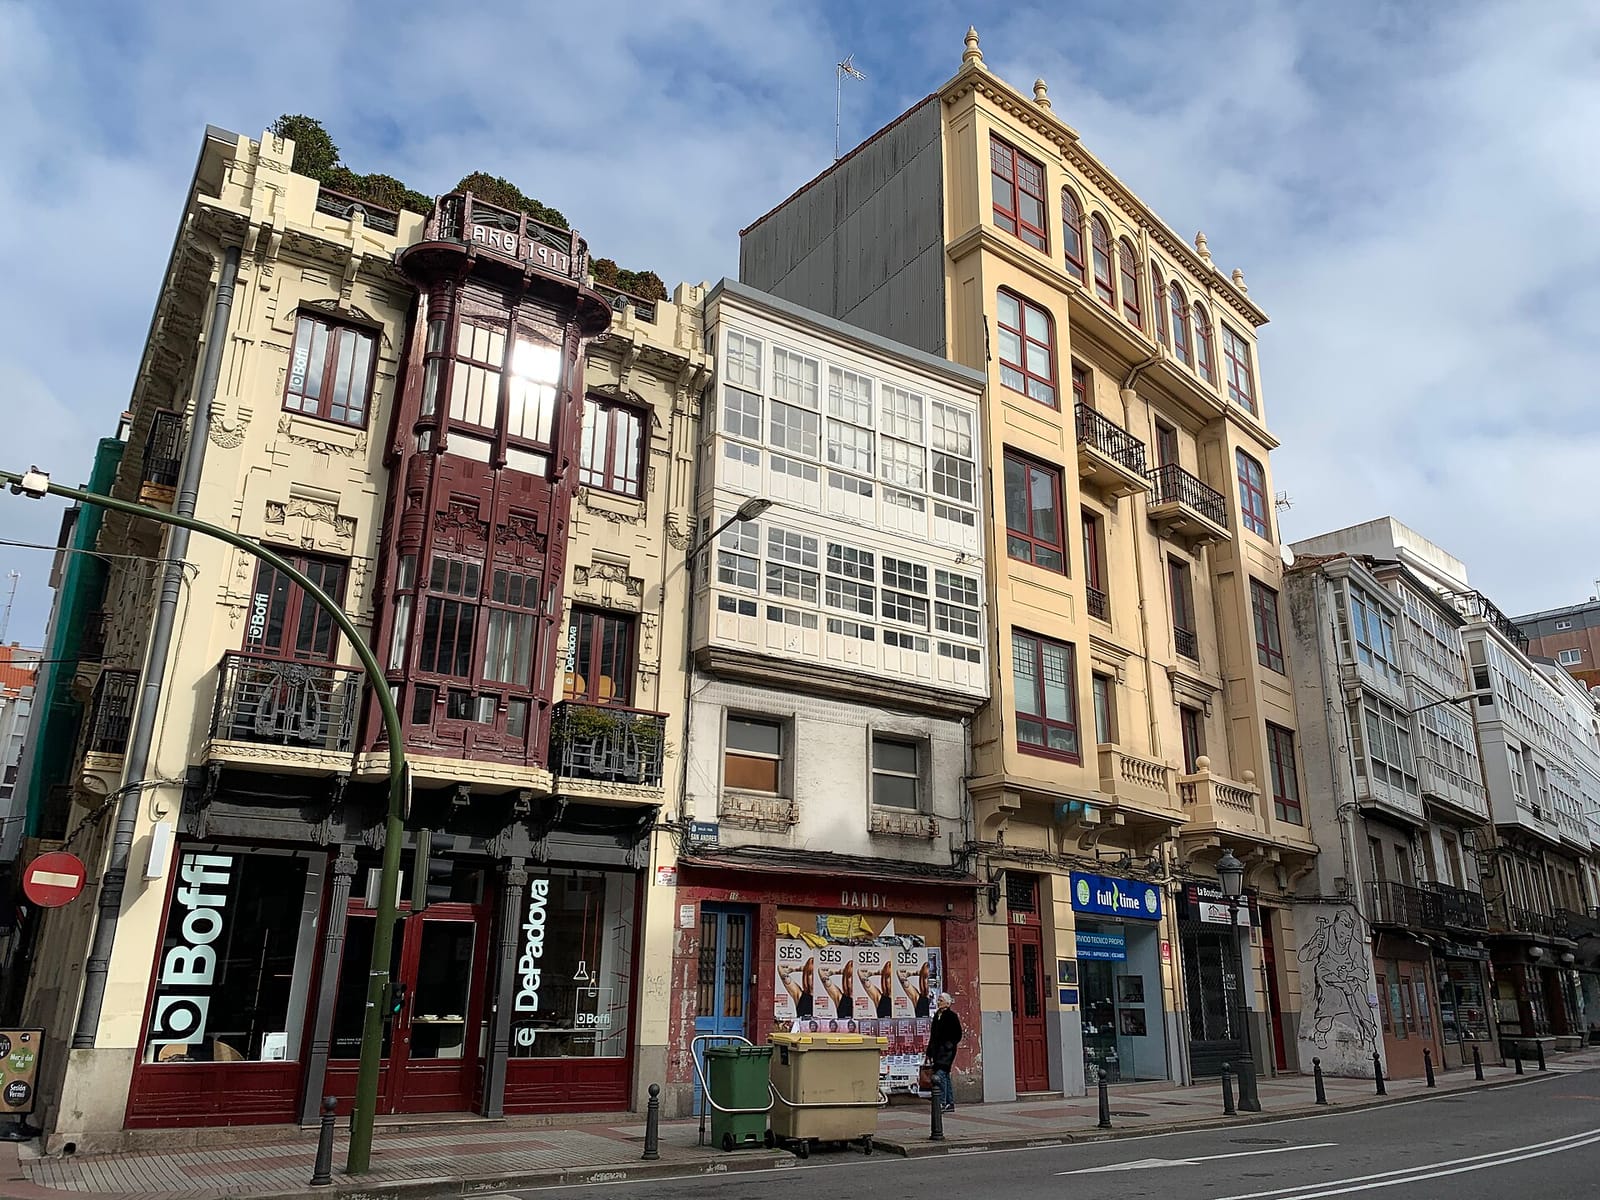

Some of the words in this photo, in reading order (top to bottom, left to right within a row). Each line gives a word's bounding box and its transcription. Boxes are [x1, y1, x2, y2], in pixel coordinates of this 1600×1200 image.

[527, 242, 567, 271] 1911
[251, 593, 269, 626] Boffi
[565, 626, 577, 673] DePadova
[841, 890, 886, 908] DANDY
[1097, 890, 1112, 906] full
[1119, 893, 1140, 909] time
[1197, 887, 1203, 896] La
[161, 853, 233, 986] Boffi
[1014, 913, 1025, 924] 114
[515, 878, 549, 1012] DePadova
[779, 944, 802, 959] SÉS
[819, 947, 842, 962] SÉS
[858, 949, 880, 963] SÉS
[586, 1013, 610, 1025] Boffi
